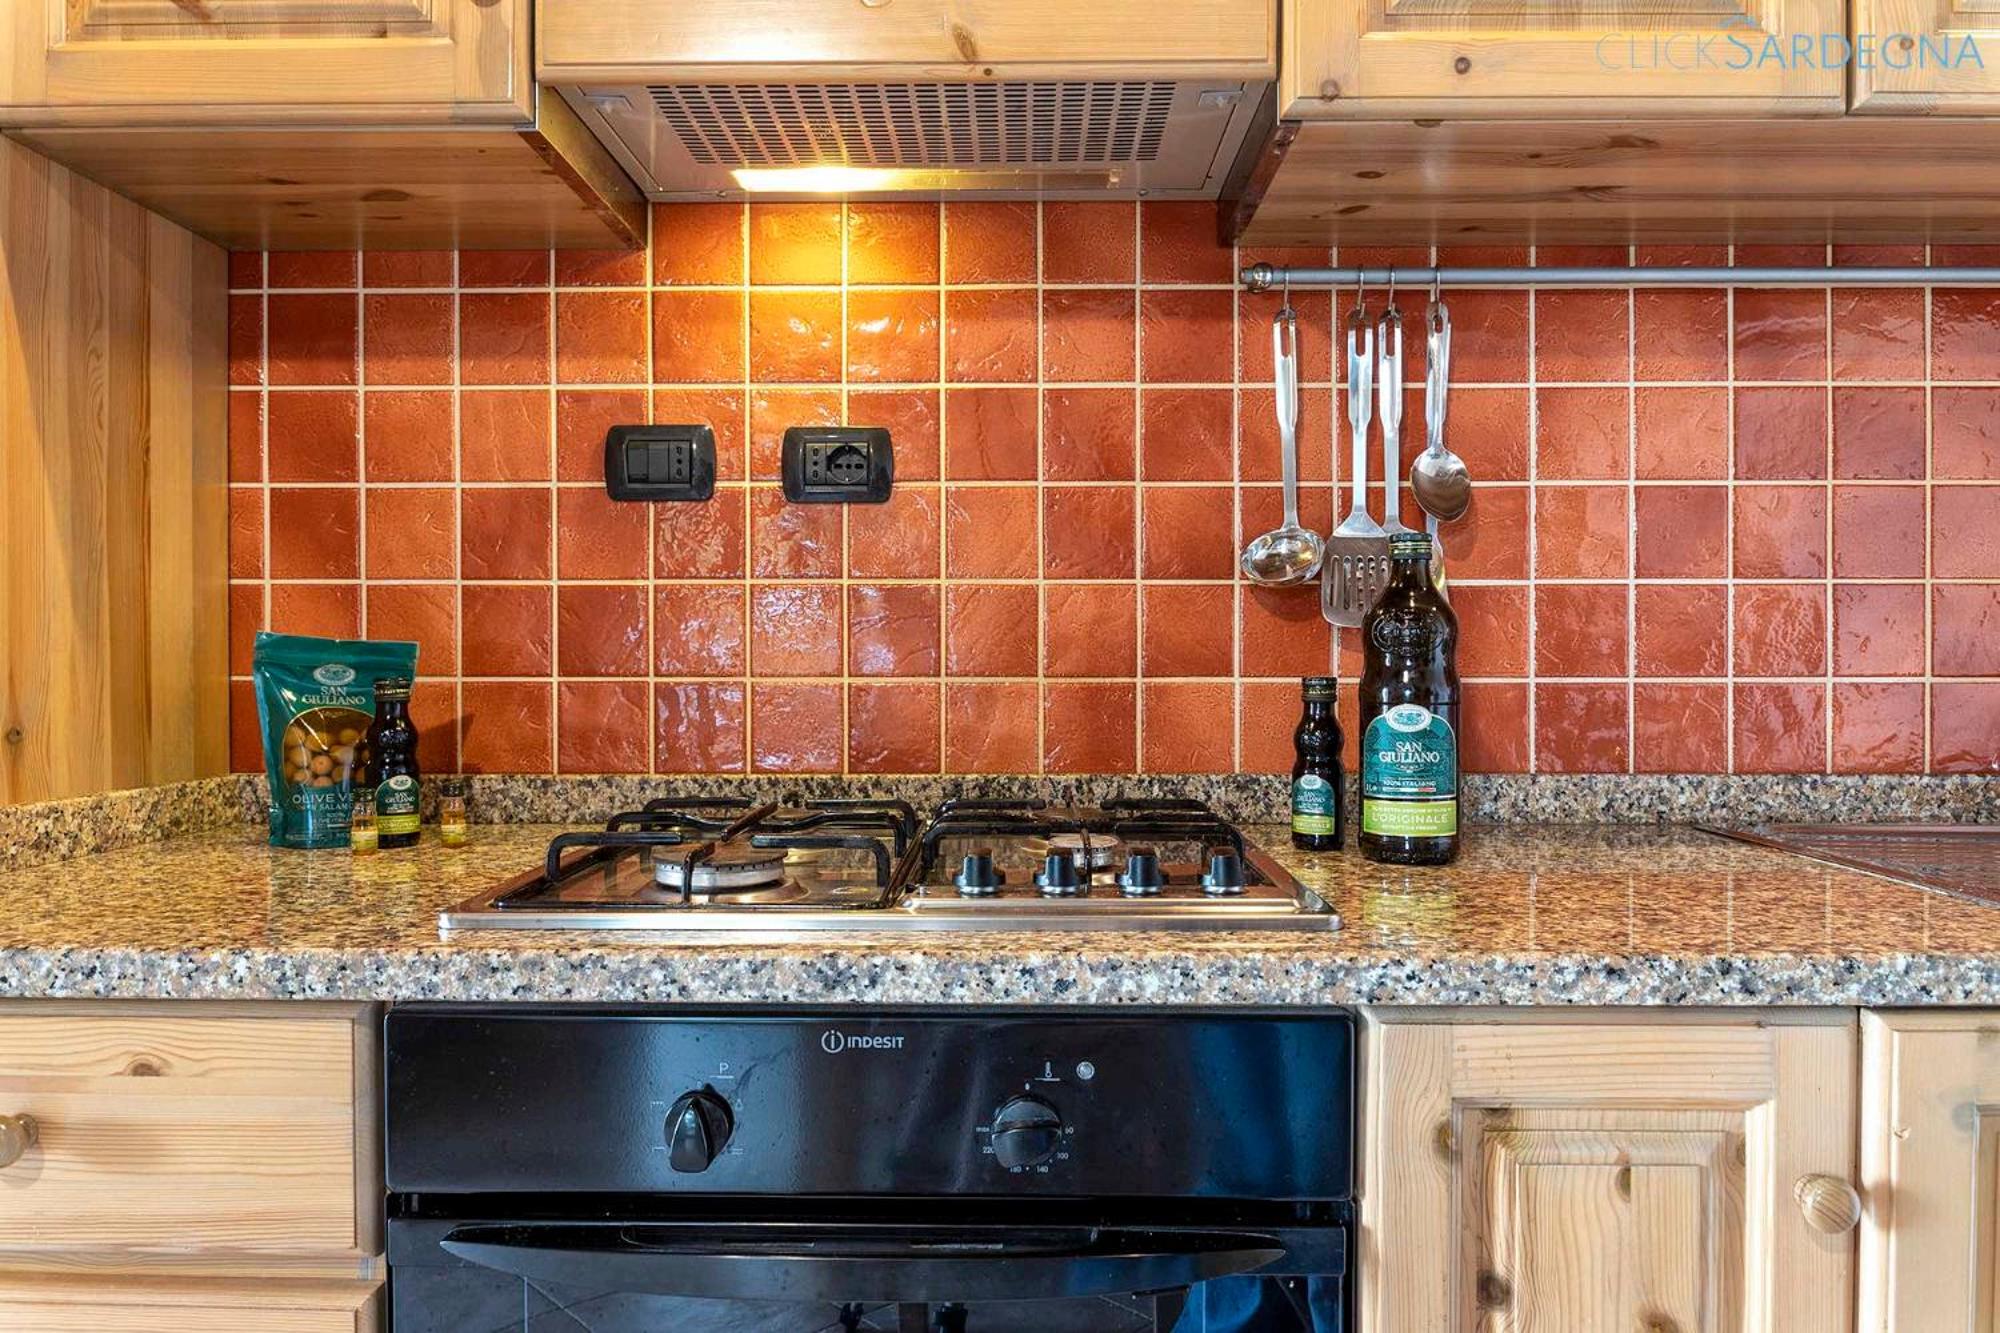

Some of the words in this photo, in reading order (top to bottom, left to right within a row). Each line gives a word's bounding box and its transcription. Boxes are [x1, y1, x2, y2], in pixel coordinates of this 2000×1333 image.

[321, 686, 346, 696] SAN
[302, 694, 366, 705] GIULIANO
[1396, 742, 1422, 752] SAN
[1379, 751, 1440, 763] GIULIANO
[292, 793, 335, 804] OLIVE
[719, 1062, 729, 1075] P
